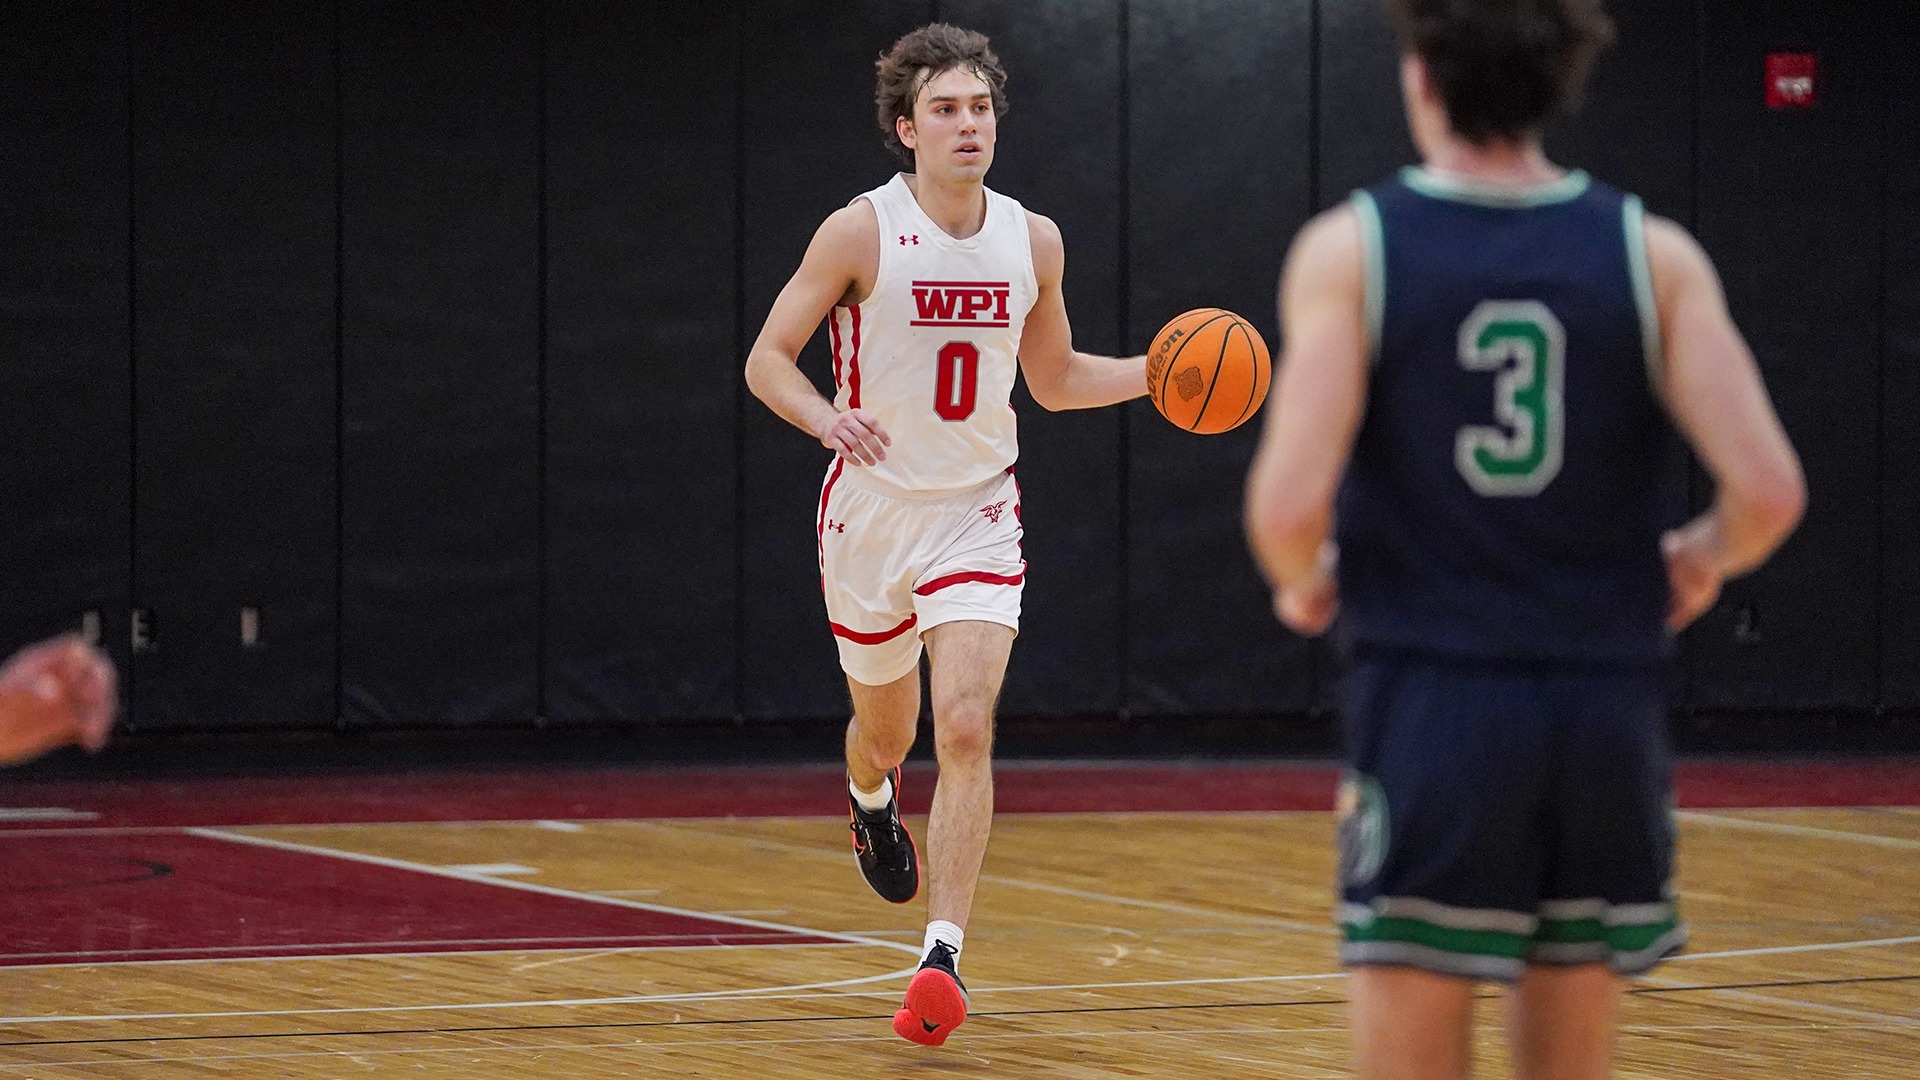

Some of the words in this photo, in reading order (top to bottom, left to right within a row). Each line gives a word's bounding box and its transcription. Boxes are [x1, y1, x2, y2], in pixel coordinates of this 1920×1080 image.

[911, 288, 1010, 321] WPI
[933, 340, 980, 422] 0
[1455, 299, 1567, 497] 3
